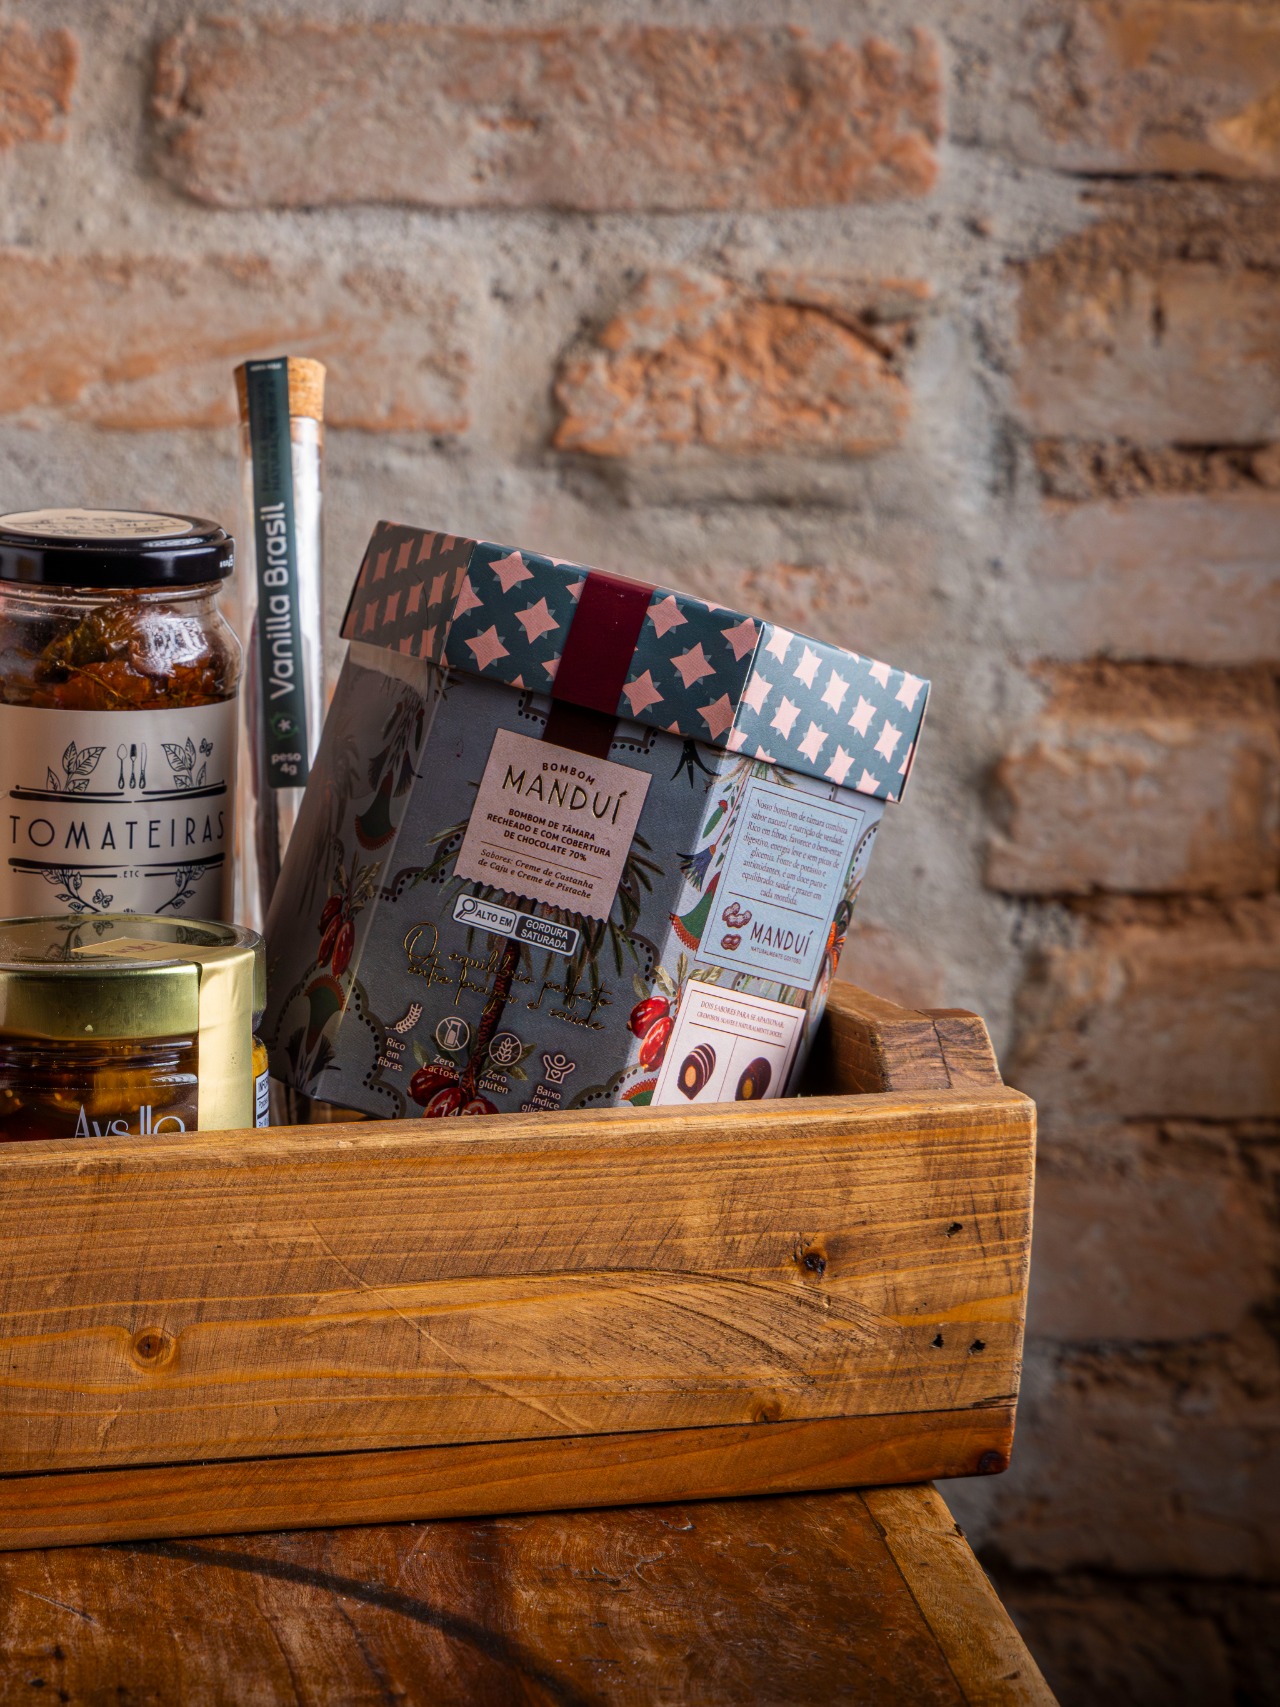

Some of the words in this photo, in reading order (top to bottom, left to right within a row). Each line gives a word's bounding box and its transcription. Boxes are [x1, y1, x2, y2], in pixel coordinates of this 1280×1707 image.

[260, 502, 290, 587] Brasil
[269, 594, 296, 700] Vanilla
[271, 751, 301, 766] peso
[279, 762, 298, 776] 4g
[542, 762, 596, 786] BOMBOM
[501, 765, 628, 825] MANDUÍ
[8, 811, 225, 851] TOMATEIRAS
[486, 813, 531, 833] RECHEADO
[532, 826, 539, 835] E
[540, 829, 560, 842] COM
[560, 836, 611, 857] COBERTURA
[508, 808, 547, 826] BOMBOM
[548, 820, 559, 830] DE
[561, 823, 596, 842] TÂMARA
[747, 821, 761, 833] Rico
[503, 829, 515, 840] DE
[516, 834, 567, 855] CHOCOLATE
[568, 849, 588, 862] 70%
[477, 857, 489, 867] de
[489, 861, 509, 876] Caju
[517, 869, 544, 885] Creme
[544, 876, 556, 888] de
[556, 881, 592, 900] Pistache
[480, 848, 514, 865] Sabores:
[515, 859, 542, 874] Creme
[542, 865, 554, 877] de
[554, 870, 594, 890] Castanha
[475, 909, 498, 923] ALTO
[499, 916, 513, 928] EM
[520, 928, 568, 950] SATURADA
[525, 919, 569, 940] GORDURA
[750, 921, 814, 957] MANDUÍ
[386, 1037, 406, 1051] Rico
[377, 1056, 403, 1072] fibras
[386, 1050, 400, 1060] em
[433, 1054, 455, 1068] Zero
[485, 1069, 507, 1083] Zero
[478, 1079, 509, 1095] glúten
[536, 1085, 561, 1100] Baixo
[532, 1094, 560, 1111] índice
